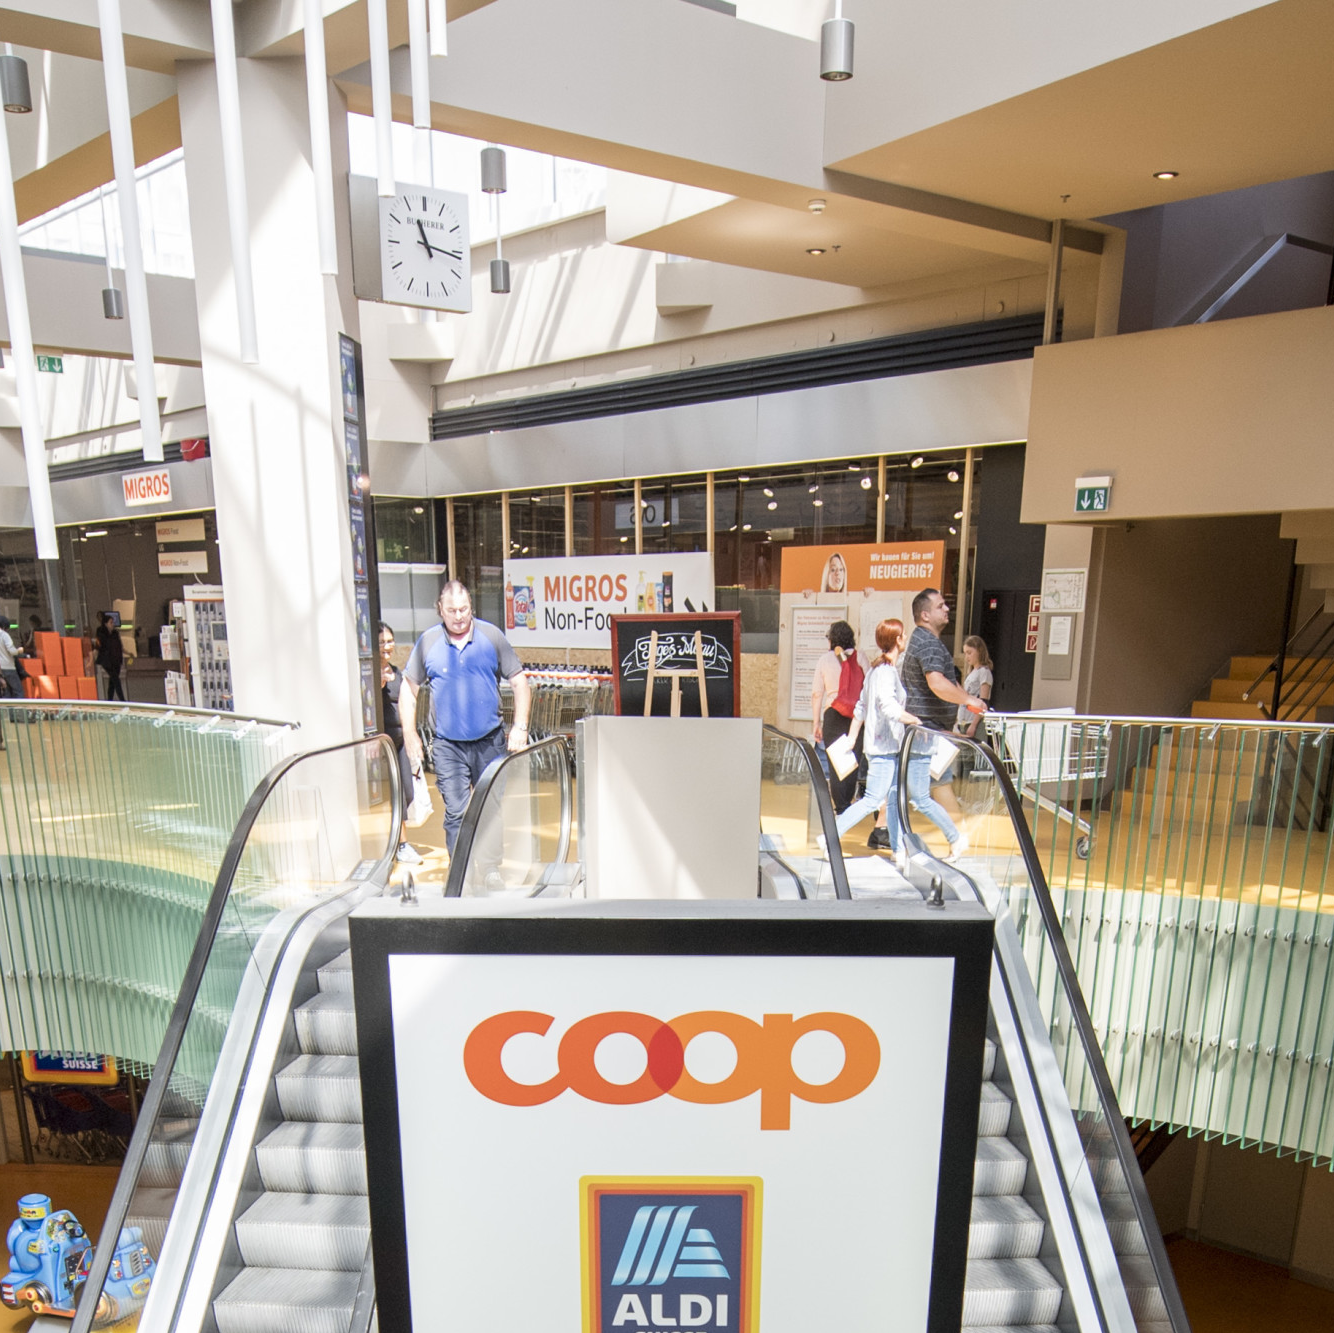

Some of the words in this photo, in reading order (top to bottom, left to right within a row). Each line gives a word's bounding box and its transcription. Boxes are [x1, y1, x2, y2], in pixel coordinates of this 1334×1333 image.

[407, 217, 444, 230] BUHERER
[124, 473, 170, 500] MIGROS
[882, 553, 900, 561] bauen
[901, 552, 909, 560] für
[912, 552, 921, 560] Sie
[870, 563, 934, 579] NEUGIERIG?
[544, 574, 627, 602] MIGROS
[545, 606, 627, 630] Non-Foo
[62, 1059, 98, 1070] SUISSE
[463, 1010, 881, 1131] coop
[612, 1294, 727, 1327] ALDI
